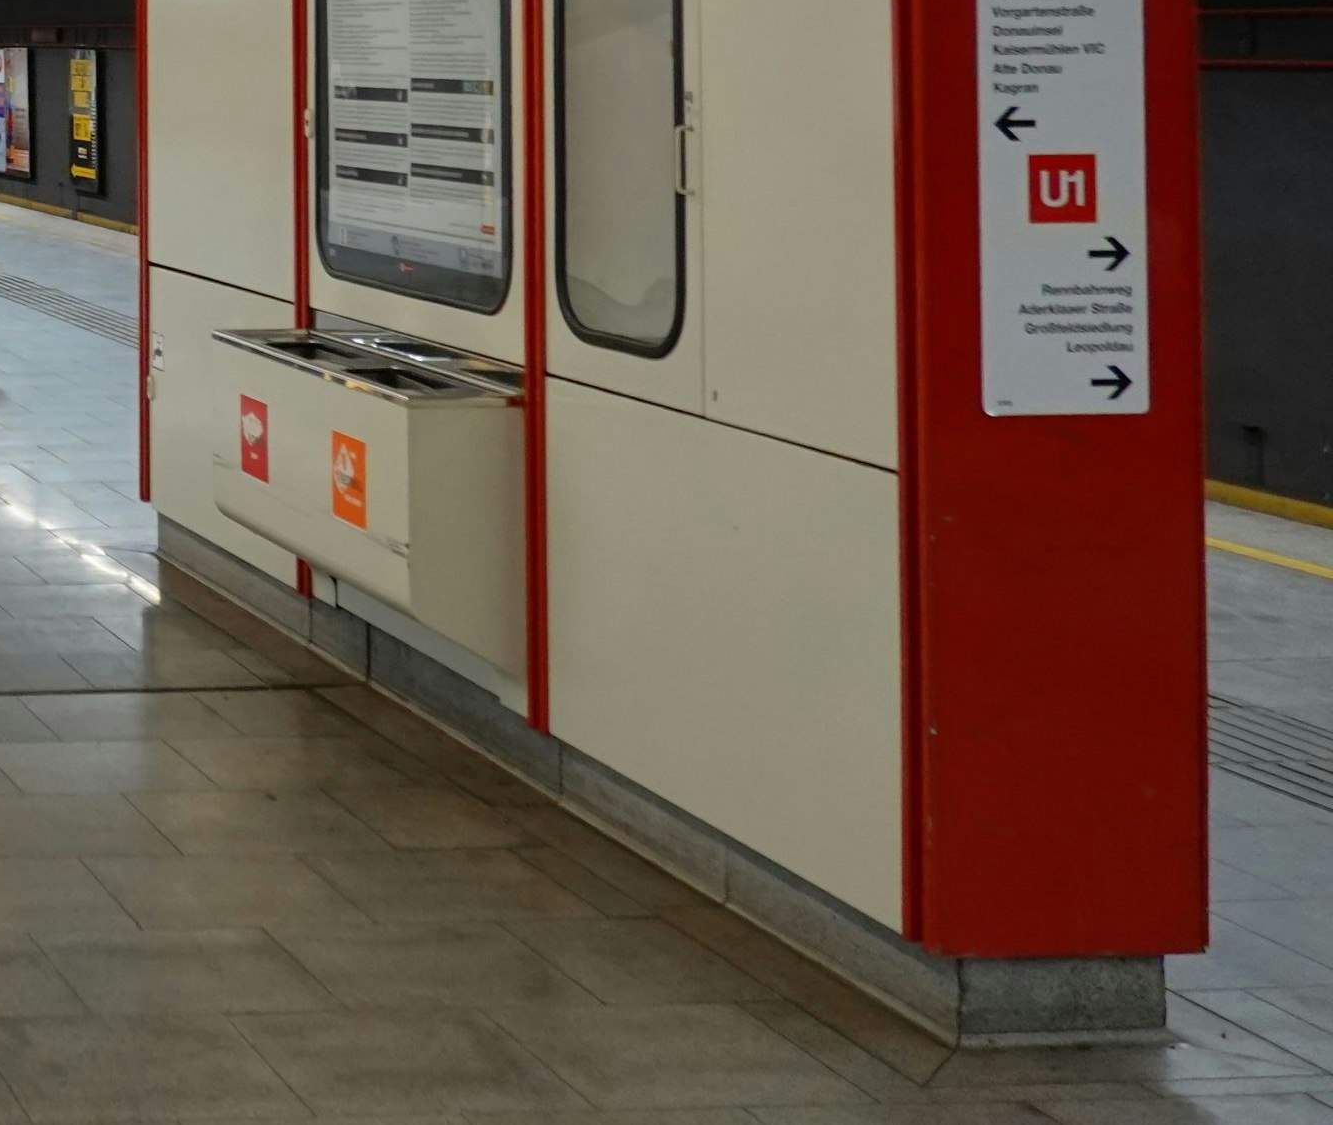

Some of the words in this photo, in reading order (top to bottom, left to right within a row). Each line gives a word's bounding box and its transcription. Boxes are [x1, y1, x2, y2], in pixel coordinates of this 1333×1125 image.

[992, 5, 1096, 21] Vorgartenstraße
[992, 24, 1064, 38] Donauinsel
[992, 43, 1080, 57] Kaisermühlen
[1082, 43, 1107, 57] VIC
[992, 62, 1018, 75] Alte
[1020, 62, 1064, 76] Donau
[993, 81, 1041, 97] Kagran
[1038, 169, 1087, 209] U1
[1041, 283, 1133, 300] Rennbahnweg
[1090, 302, 1134, 316] Straße
[1023, 321, 1134, 337] Großfeldsiedlung
[1065, 341, 1135, 355] Leopoldau
